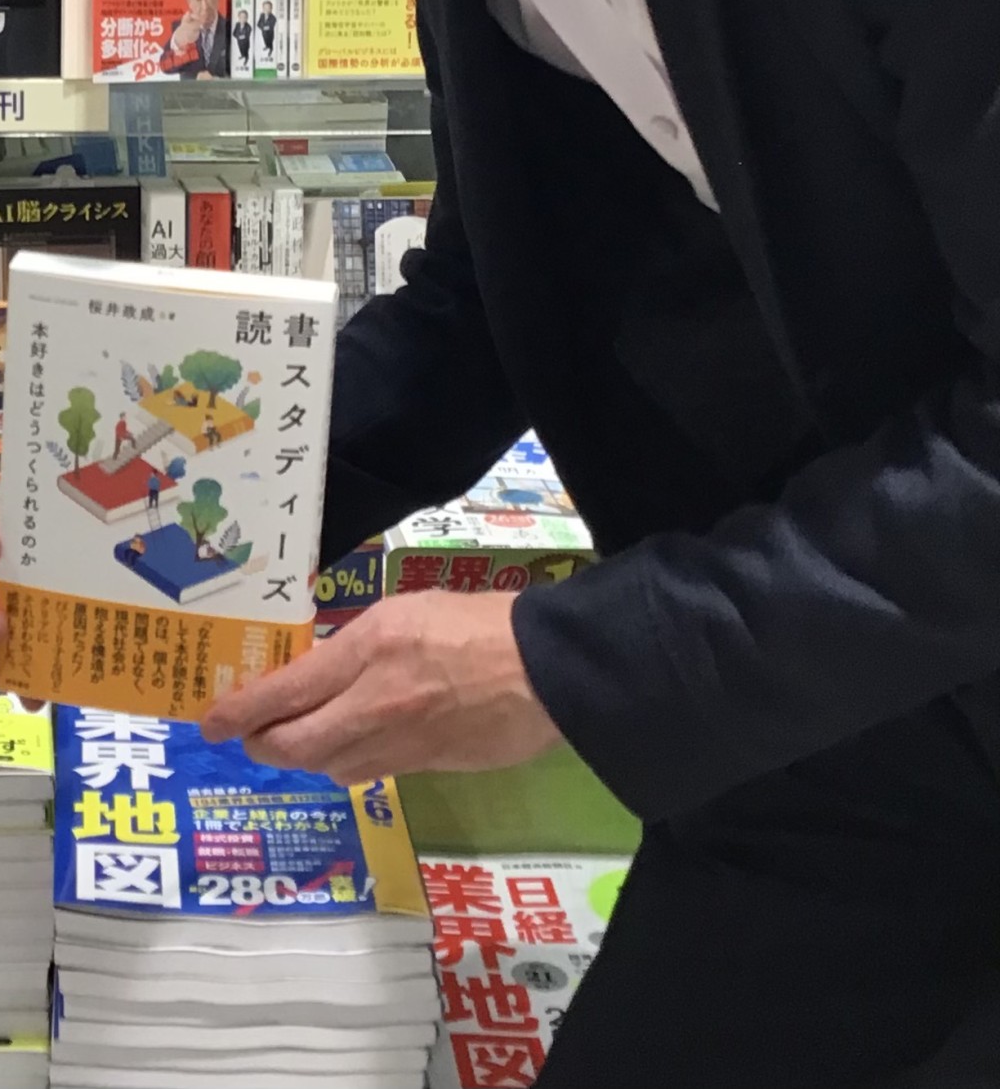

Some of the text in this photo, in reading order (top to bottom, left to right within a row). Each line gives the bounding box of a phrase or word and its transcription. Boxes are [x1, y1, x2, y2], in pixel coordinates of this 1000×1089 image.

[101, 18, 164, 38] 分断から
[101, 39, 164, 59] 多極化へ
[152, 220, 172, 238] AI
[151, 244, 183, 260] 過大
[20, 321, 49, 567] 本好きはどうつくられるのか
[193, 809, 347, 822] 企業と経済の今が
[201, 834, 254, 844] 株式投資
[198, 876, 298, 906] 280
[505, 877, 578, 944] 日経
[420, 863, 548, 1089] 業界地図
